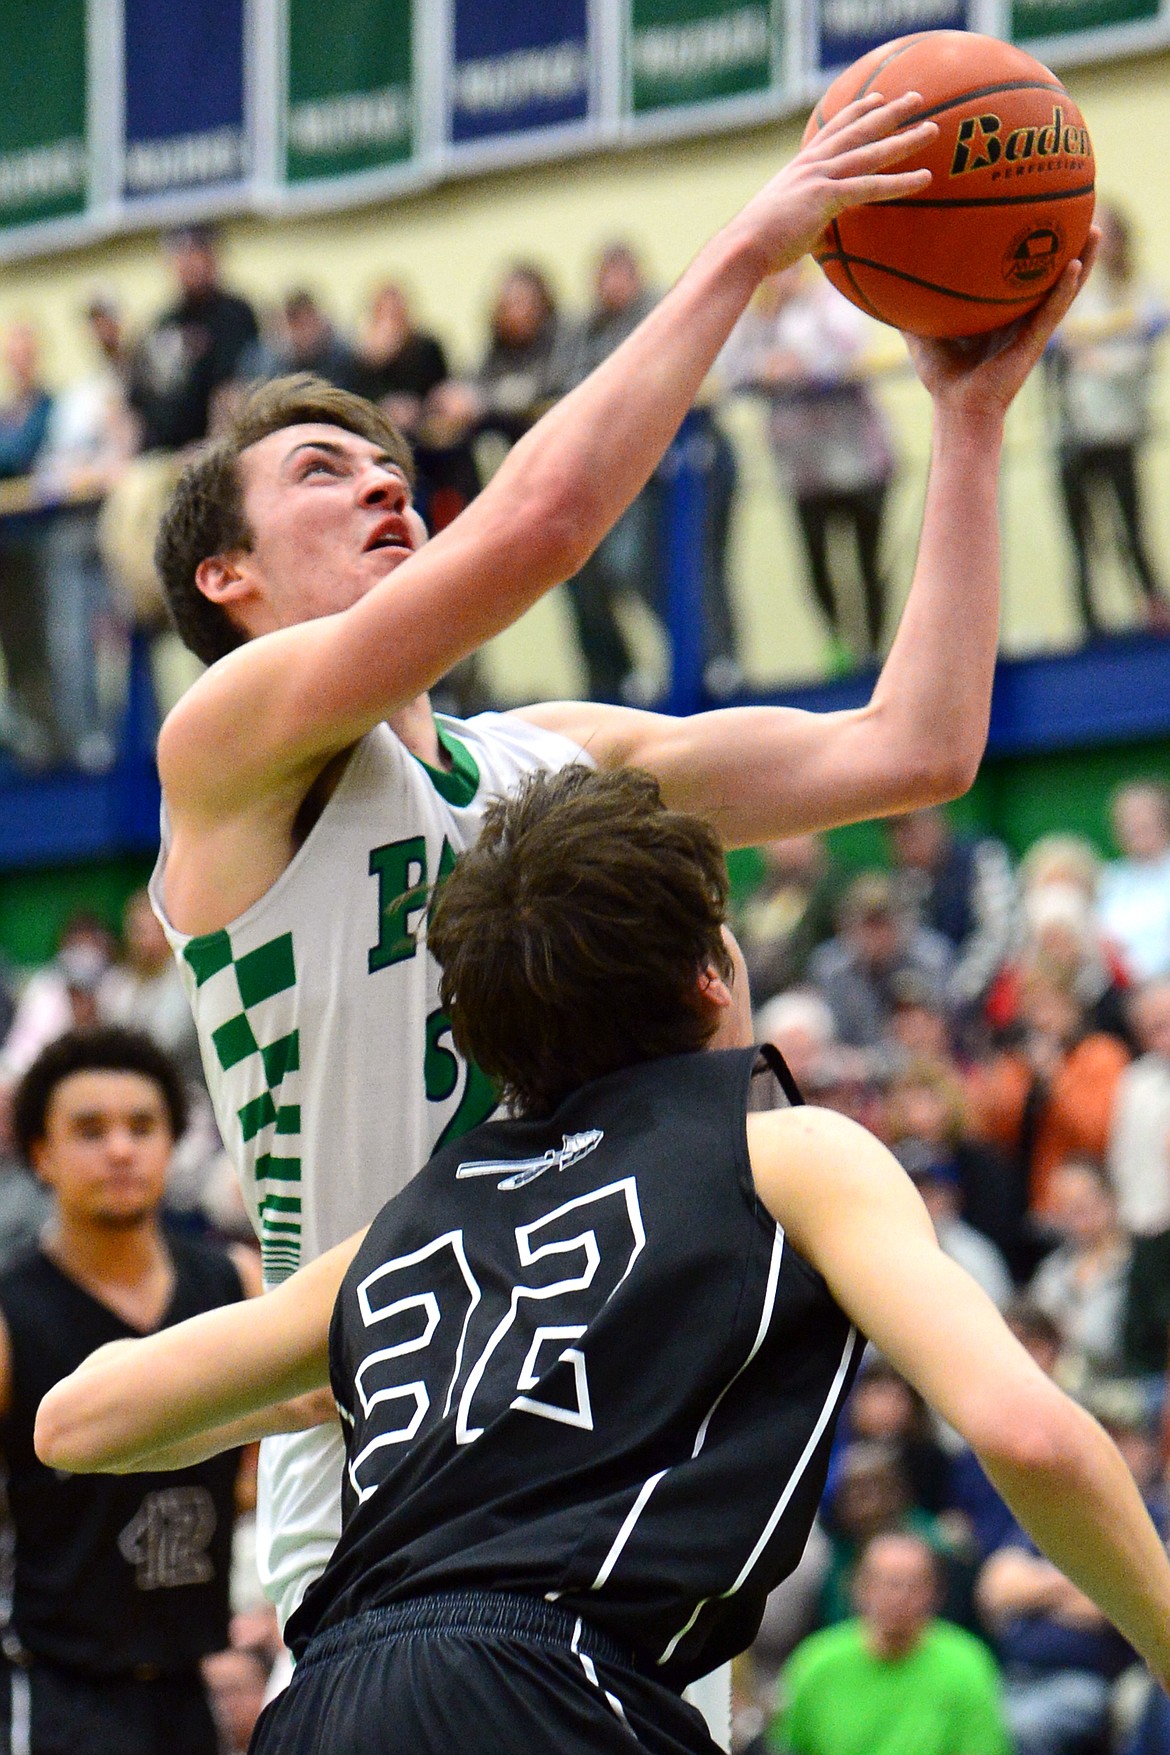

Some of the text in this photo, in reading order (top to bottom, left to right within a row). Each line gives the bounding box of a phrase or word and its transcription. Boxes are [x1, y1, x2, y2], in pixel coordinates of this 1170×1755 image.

[949, 105, 1092, 177] Baden
[348, 1175, 647, 1505] 32
[117, 1486, 218, 1591] 42
